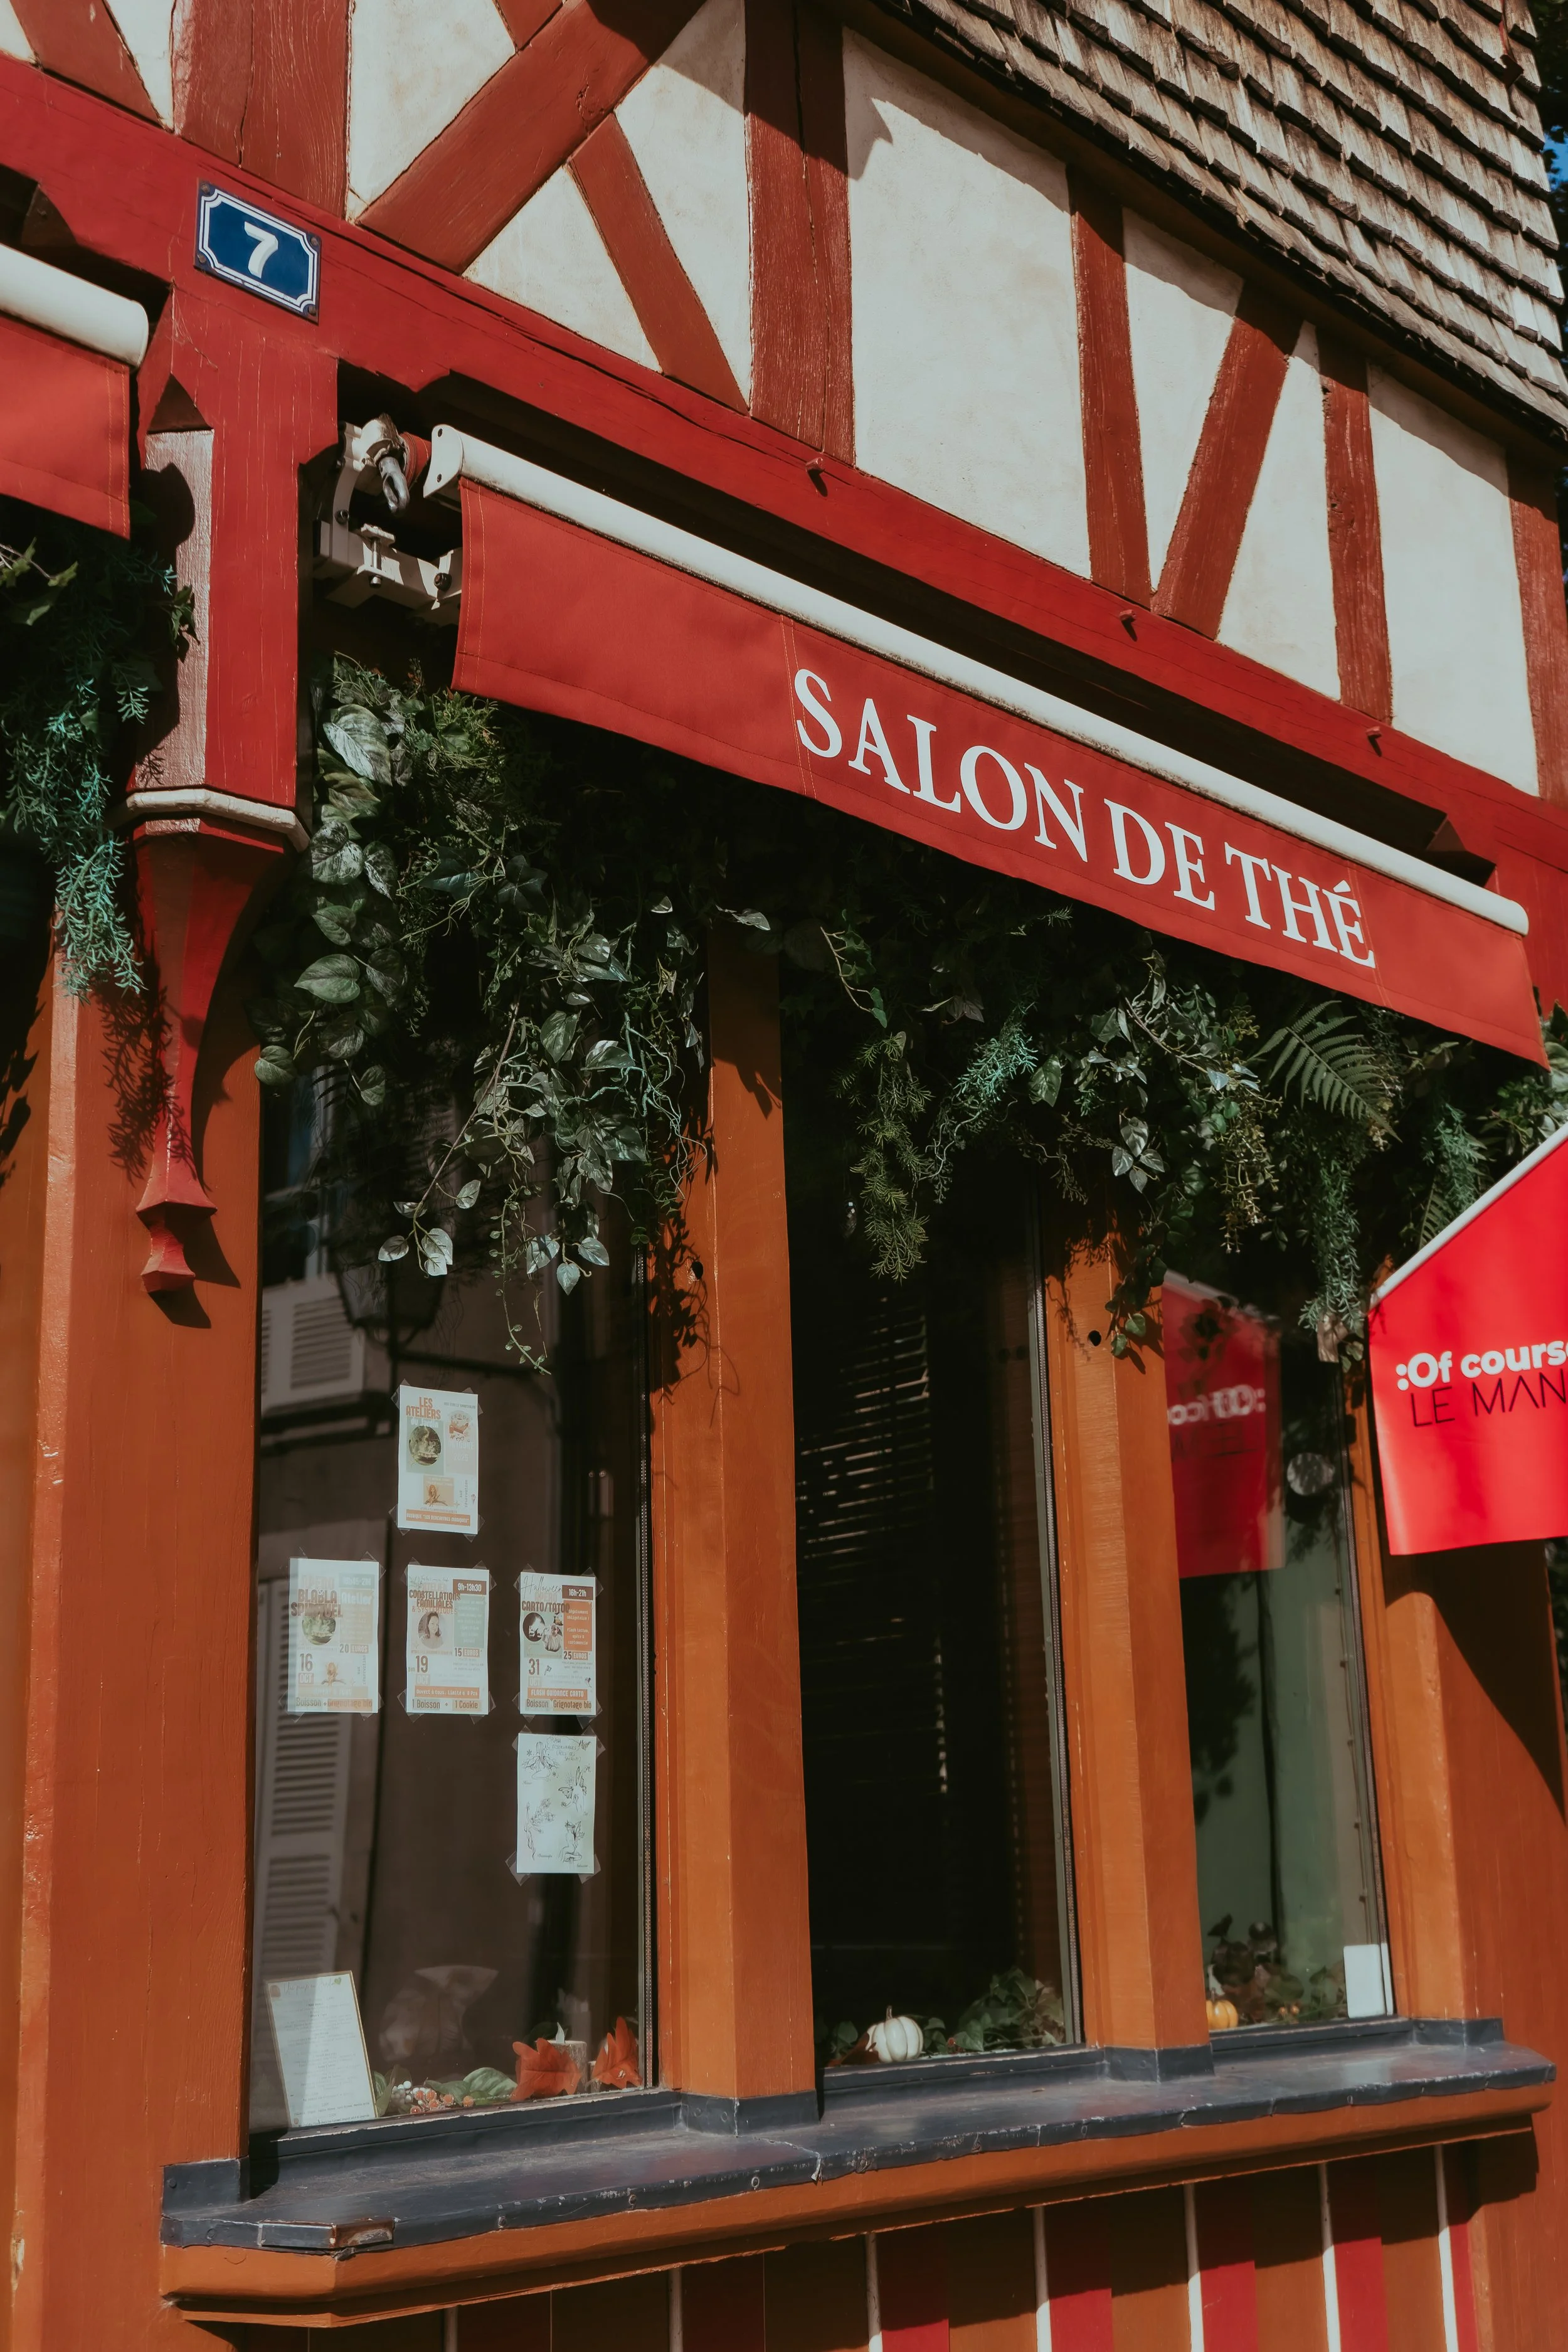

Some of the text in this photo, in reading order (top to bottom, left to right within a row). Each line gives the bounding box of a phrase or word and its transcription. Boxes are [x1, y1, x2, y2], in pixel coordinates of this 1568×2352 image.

[245, 221, 278, 279] 7
[794, 669, 1375, 969] SALON DE THÉ
[1461, 1340, 1568, 1378] cours
[419, 1397, 433, 1409] LES
[1411, 1386, 1455, 1427] LE
[406, 1406, 441, 1420] ATELIERS
[457, 1582, 482, 1592] 9h-13h30
[521, 1575, 563, 1599] Halloween
[569, 1589, 587, 1597] 16h-21h
[409, 1589, 461, 1601] CONSTELLATIONS
[416, 1599, 453, 1609] FAMILIALES
[339, 1644, 349, 1653] 20
[454, 1648, 462, 1657] 15
[563, 1651, 572, 1660] 25
[300, 1653, 313, 1671] 16
[415, 1655, 428, 1673] 19
[528, 1658, 540, 1675] 31
[299, 1673, 312, 1683] OCT
[416, 1675, 429, 1685] OCT
[296, 1697, 321, 1707] Boisson
[416, 1699, 440, 1709] Boisson
[455, 1700, 457, 1708] 1
[459, 1700, 478, 1709] Cookie
[526, 1698, 592, 1710] Boisson Grignotage bio
